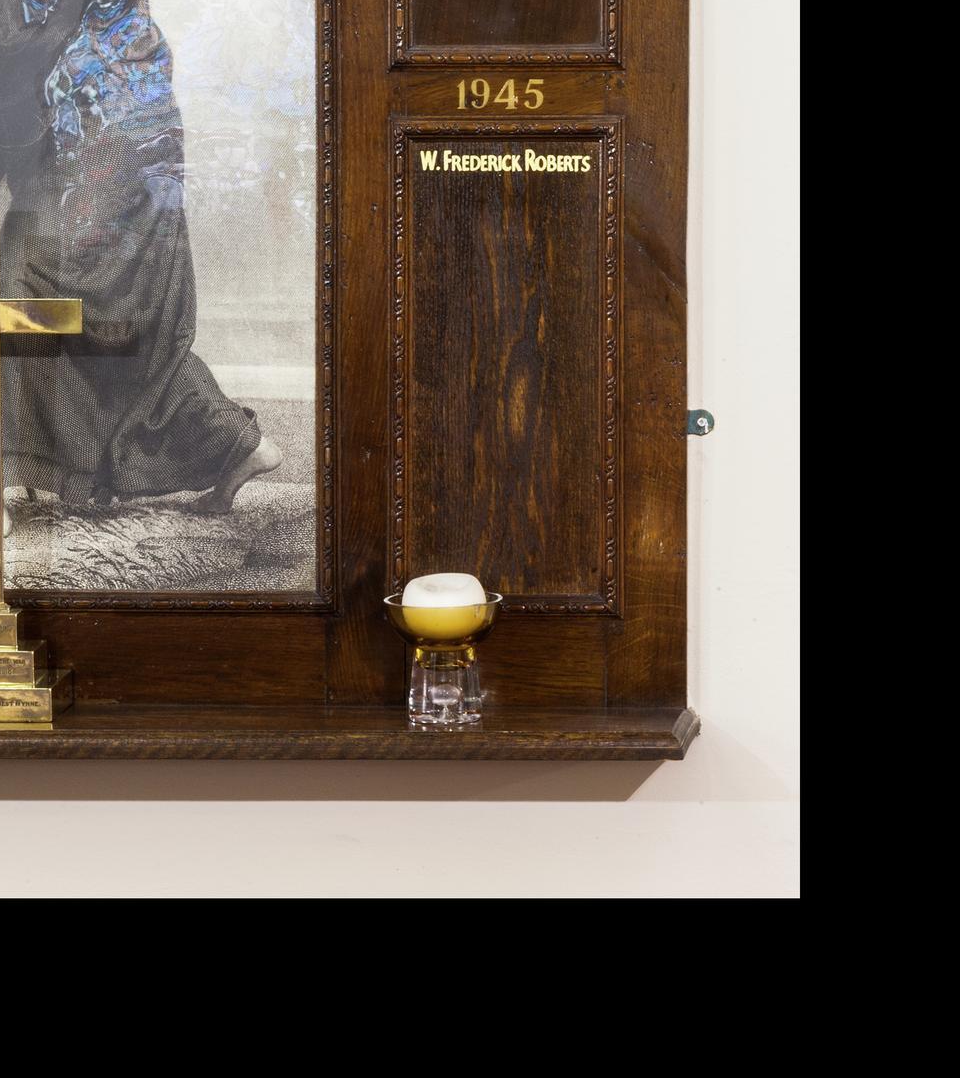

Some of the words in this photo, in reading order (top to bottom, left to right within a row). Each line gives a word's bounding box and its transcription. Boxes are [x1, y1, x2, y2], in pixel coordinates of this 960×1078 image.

[456, 78, 545, 110] 1945
[420, 150, 441, 171] W.
[443, 149, 522, 172] FREDERICK
[525, 149, 591, 172] ROBERTS
